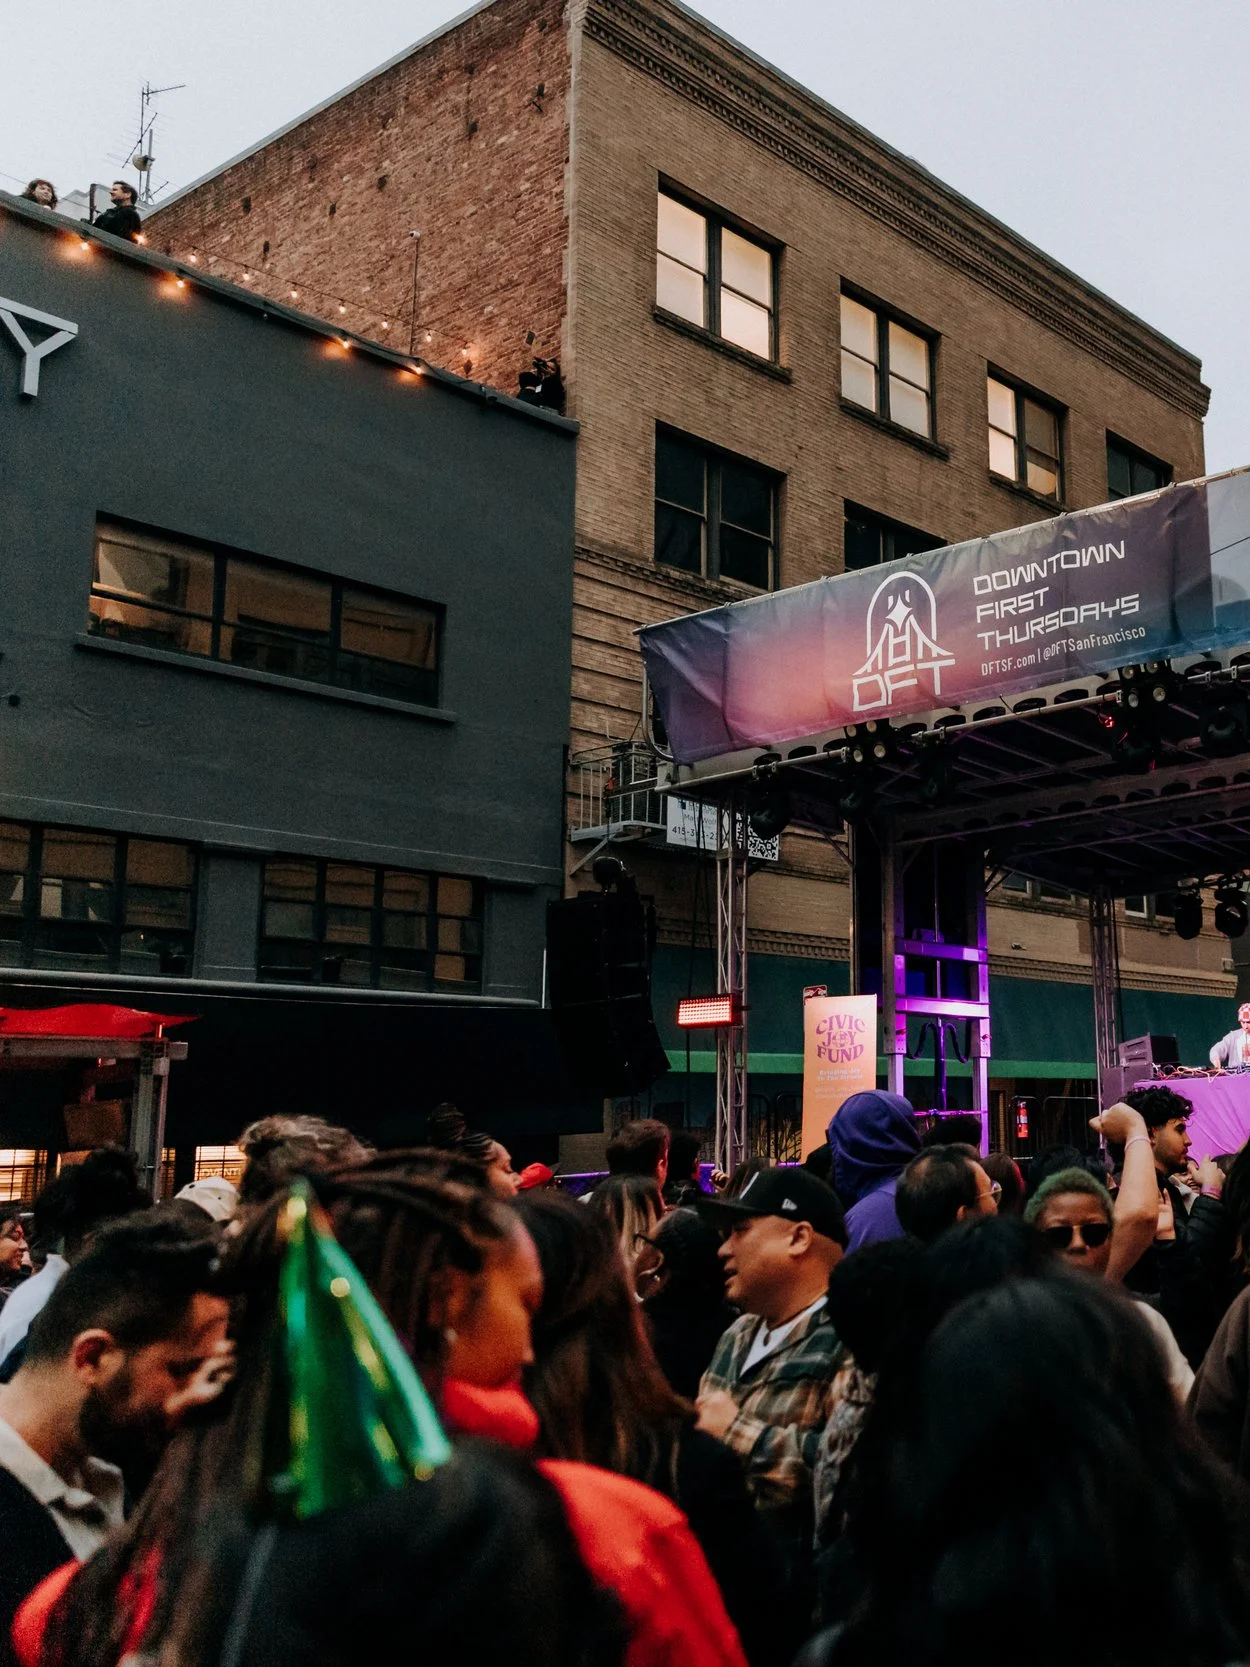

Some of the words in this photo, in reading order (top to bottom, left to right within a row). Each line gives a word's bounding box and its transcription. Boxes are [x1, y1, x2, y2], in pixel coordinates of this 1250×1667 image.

[973, 540, 1125, 596] DOWNTOWN
[976, 587, 1049, 623] FIRST
[976, 593, 1140, 650] THURSDAYS
[981, 654, 1036, 676] DFTSF.com
[1043, 626, 1146, 661] @DFTSanFrancisco
[852, 659, 956, 711] DFT
[816, 1014, 865, 1035] CIVIC
[822, 1031, 857, 1047] JOY
[817, 1044, 864, 1063] FUND
